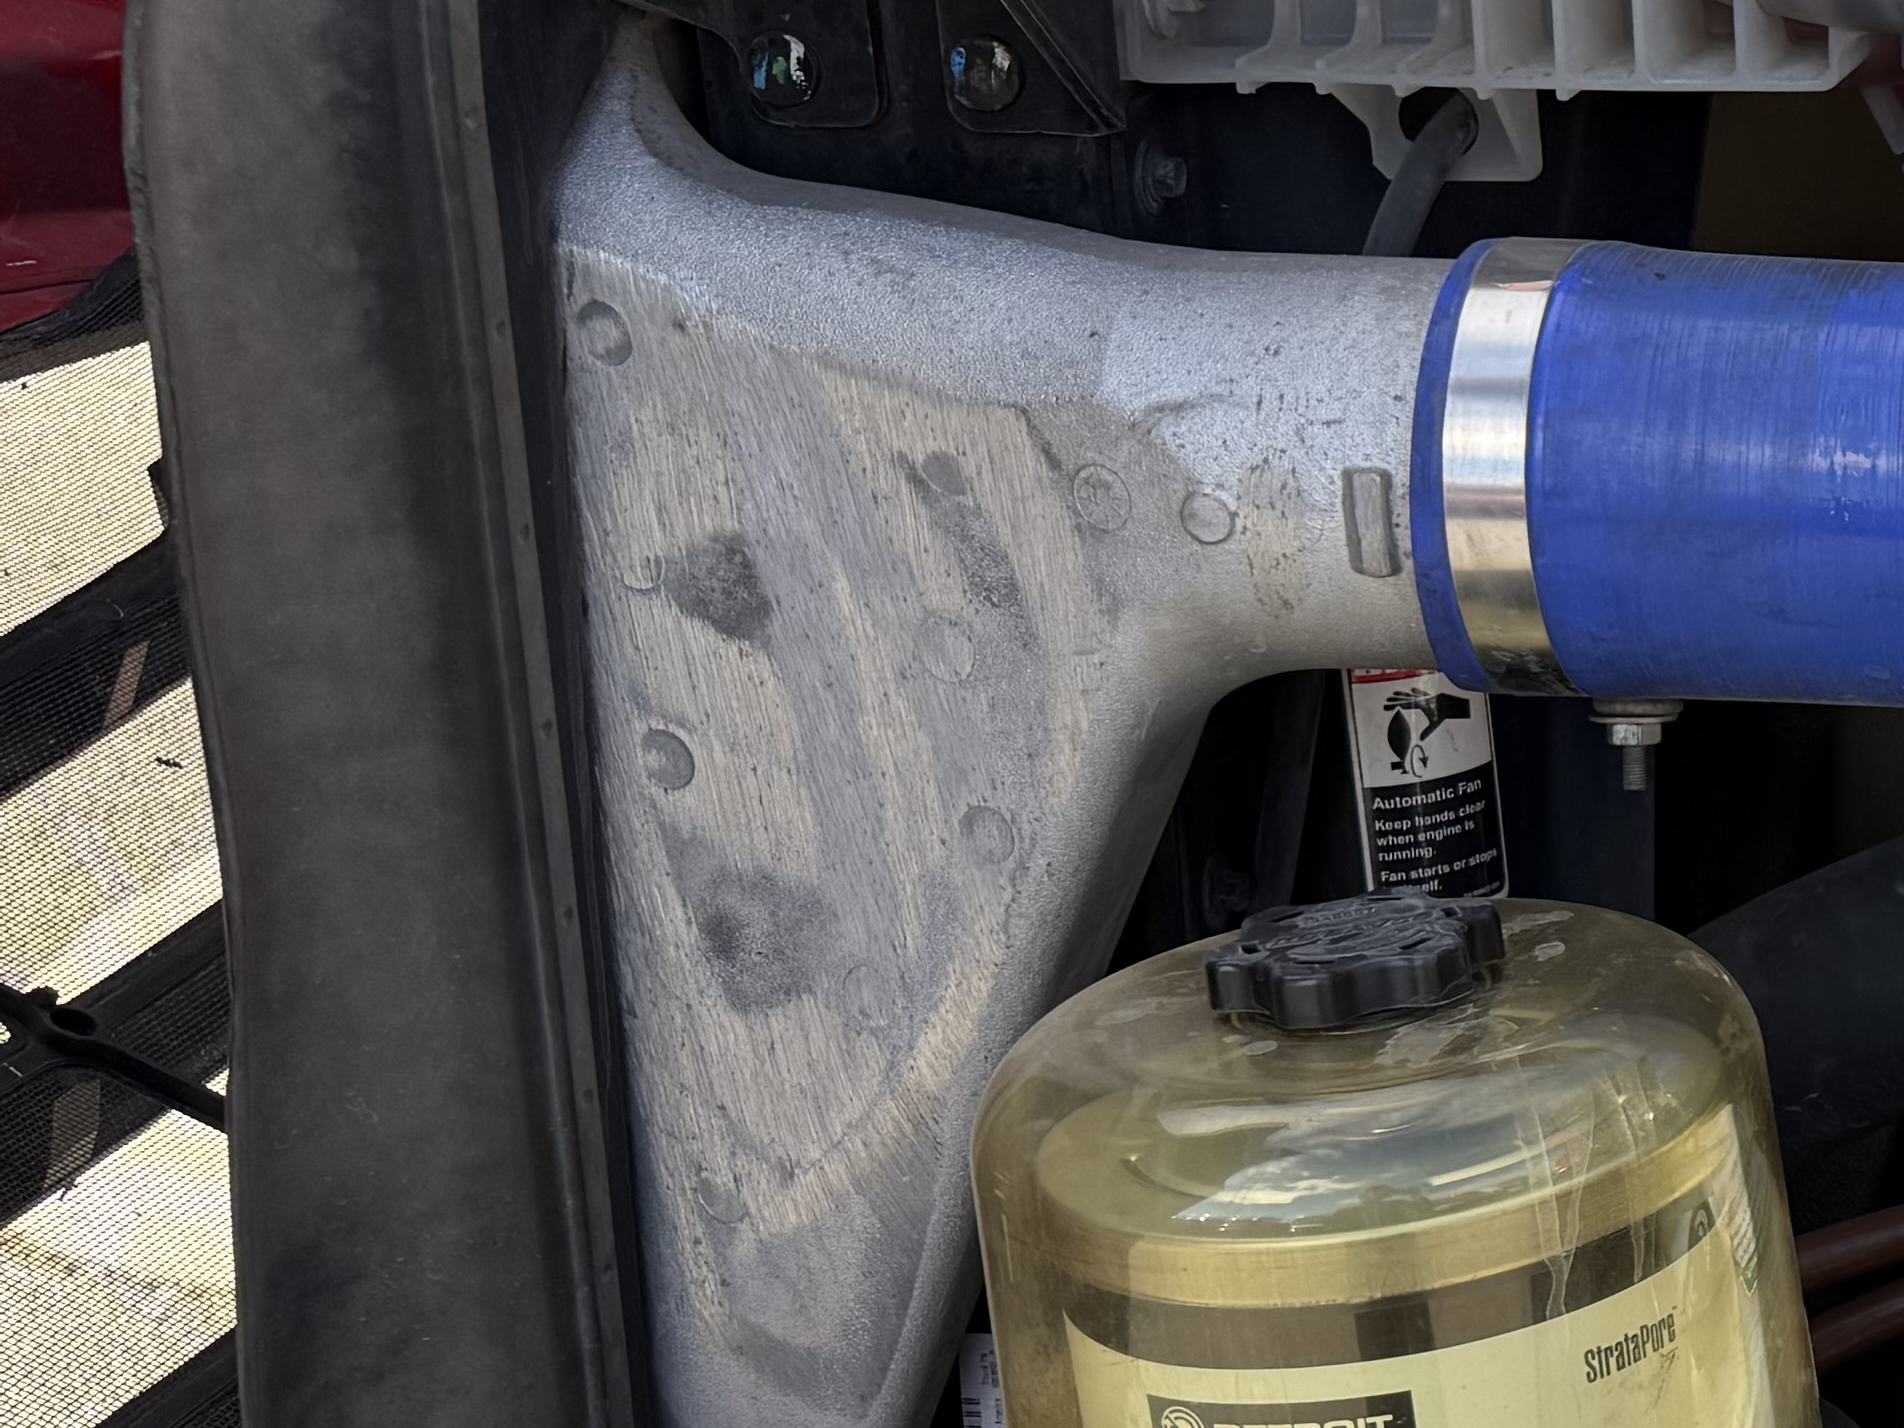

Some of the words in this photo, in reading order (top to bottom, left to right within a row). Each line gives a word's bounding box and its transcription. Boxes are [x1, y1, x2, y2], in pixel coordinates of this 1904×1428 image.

[1372, 788, 1455, 810] Automatic
[1458, 779, 1482, 795] Fan
[1375, 819, 1411, 831] Keep
[1415, 810, 1456, 826] hands
[1459, 799, 1486, 817] clear
[1376, 833, 1414, 847] when
[1418, 823, 1462, 841] engine
[1464, 819, 1475, 830] is
[1378, 846, 1437, 862] running.
[1381, 871, 1406, 882] Fan
[1410, 864, 1450, 879] starts
[1453, 858, 1466, 871] or
[1469, 848, 1498, 866] stops
[1584, 1310, 1676, 1384] StrataPore
